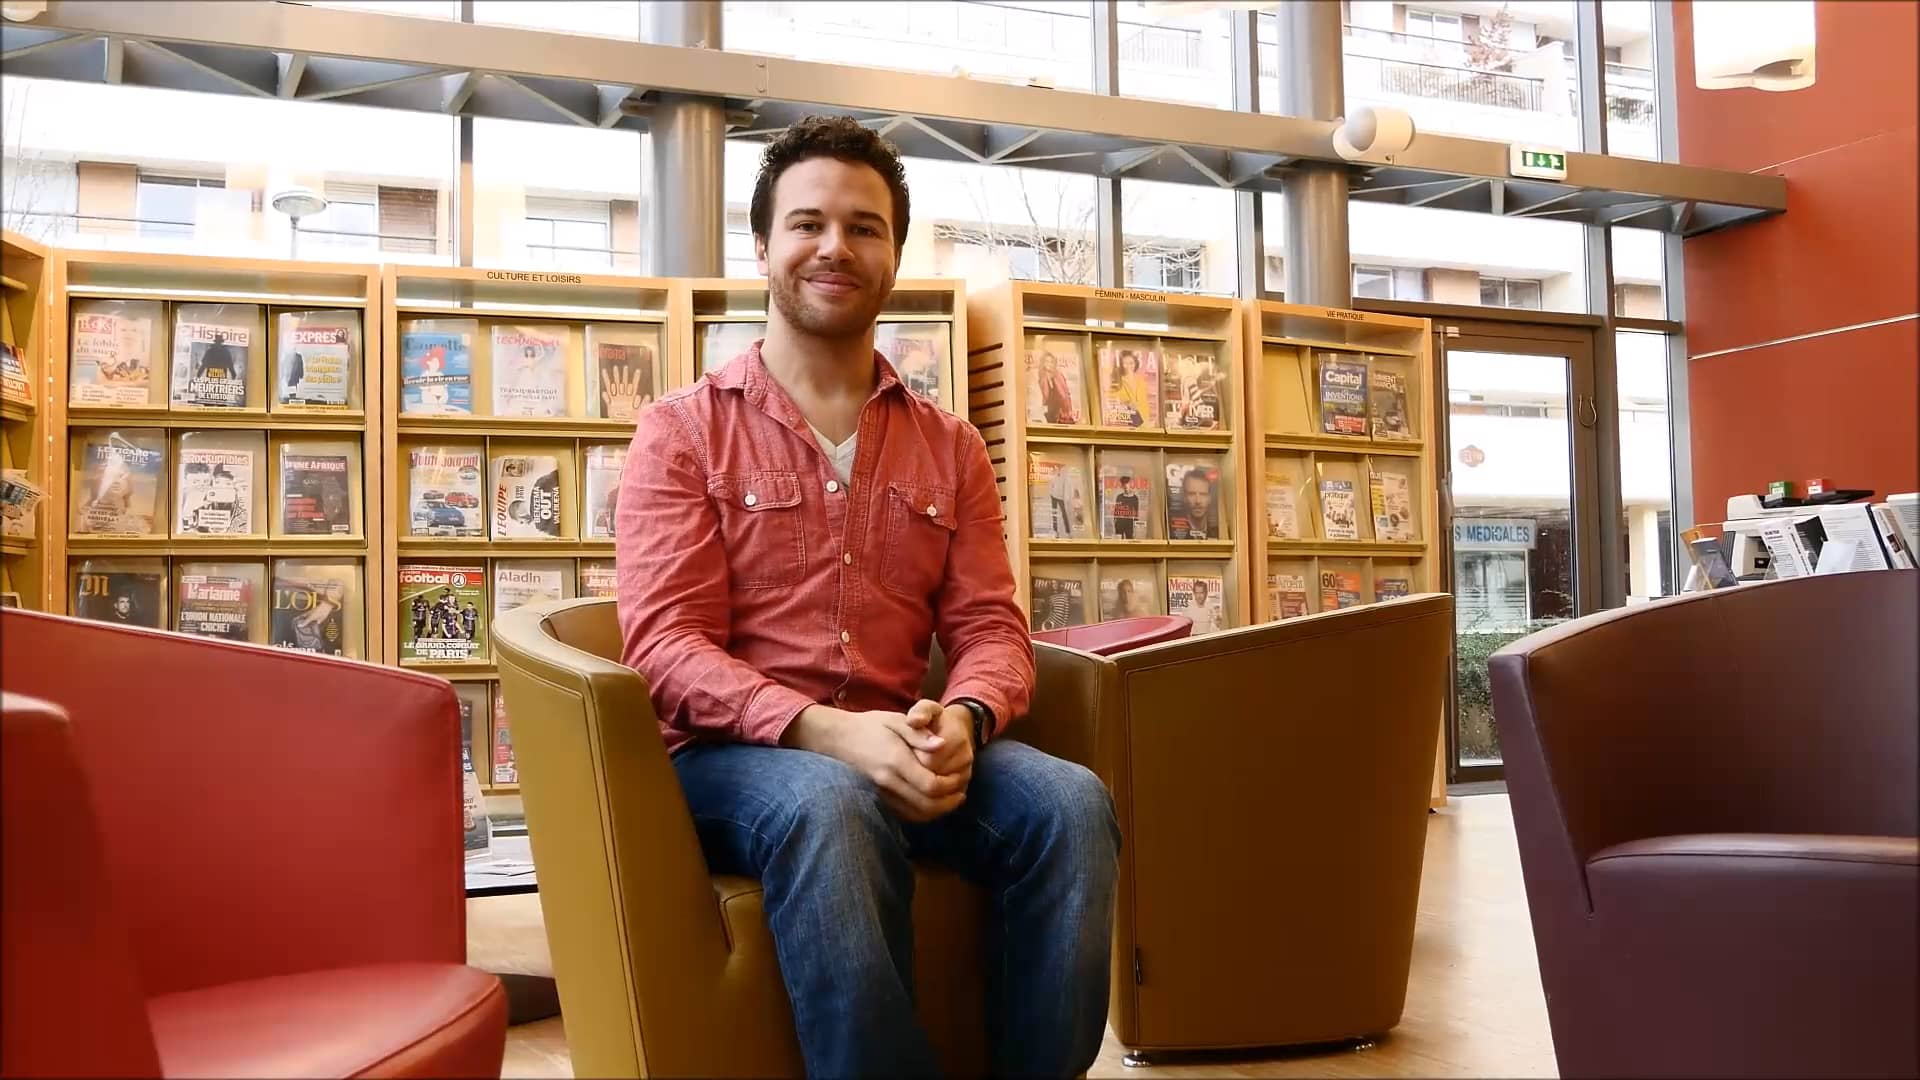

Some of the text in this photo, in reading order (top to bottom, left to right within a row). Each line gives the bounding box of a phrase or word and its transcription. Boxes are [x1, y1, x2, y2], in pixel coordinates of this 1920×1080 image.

[487, 271, 582, 284] CULTURE ET LOISIRS
[1129, 292, 1166, 302] MASCULIN
[1326, 310, 1365, 321] VIE PRATIQUE
[192, 324, 247, 343] Histoire
[1325, 371, 1362, 385] Capital
[189, 382, 245, 395] MEURTRIERS
[310, 462, 346, 472] AFRIQUE
[541, 491, 552, 520] OUT
[399, 572, 450, 584] football
[499, 571, 542, 585] Aladin
[1322, 572, 1336, 588] 60
[187, 583, 241, 601] Marianne
[181, 611, 246, 624] L'UNION NATIONALE
[429, 649, 468, 659] PARIS
